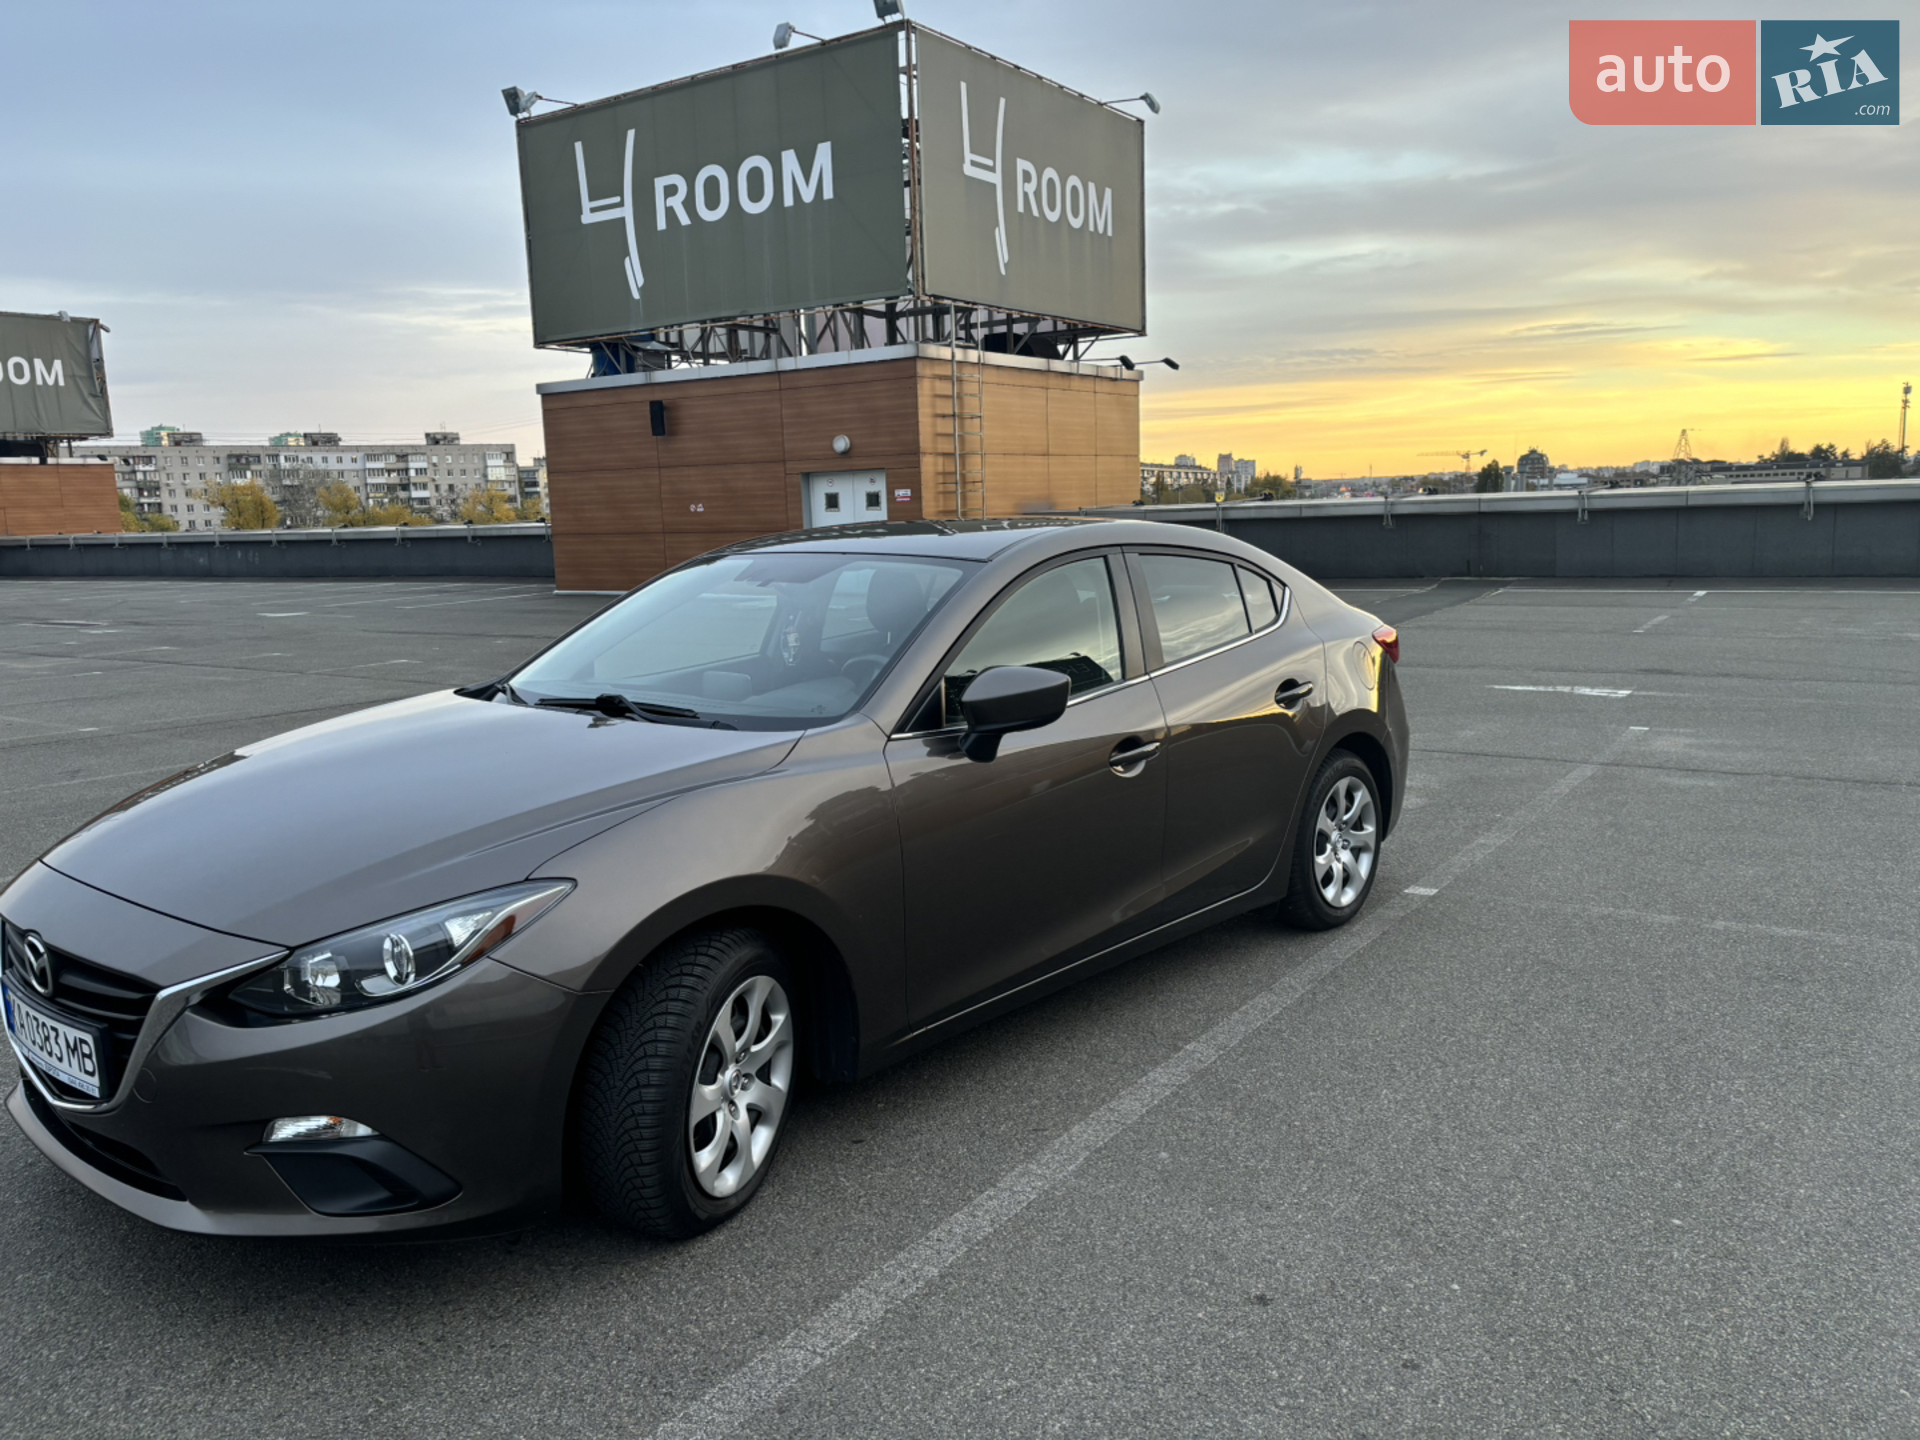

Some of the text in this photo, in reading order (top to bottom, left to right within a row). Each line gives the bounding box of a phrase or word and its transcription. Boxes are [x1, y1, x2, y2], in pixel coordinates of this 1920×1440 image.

[653, 140, 835, 232] ROOM
[1016, 156, 1114, 237] ROOM
[0, 355, 65, 387] OM
